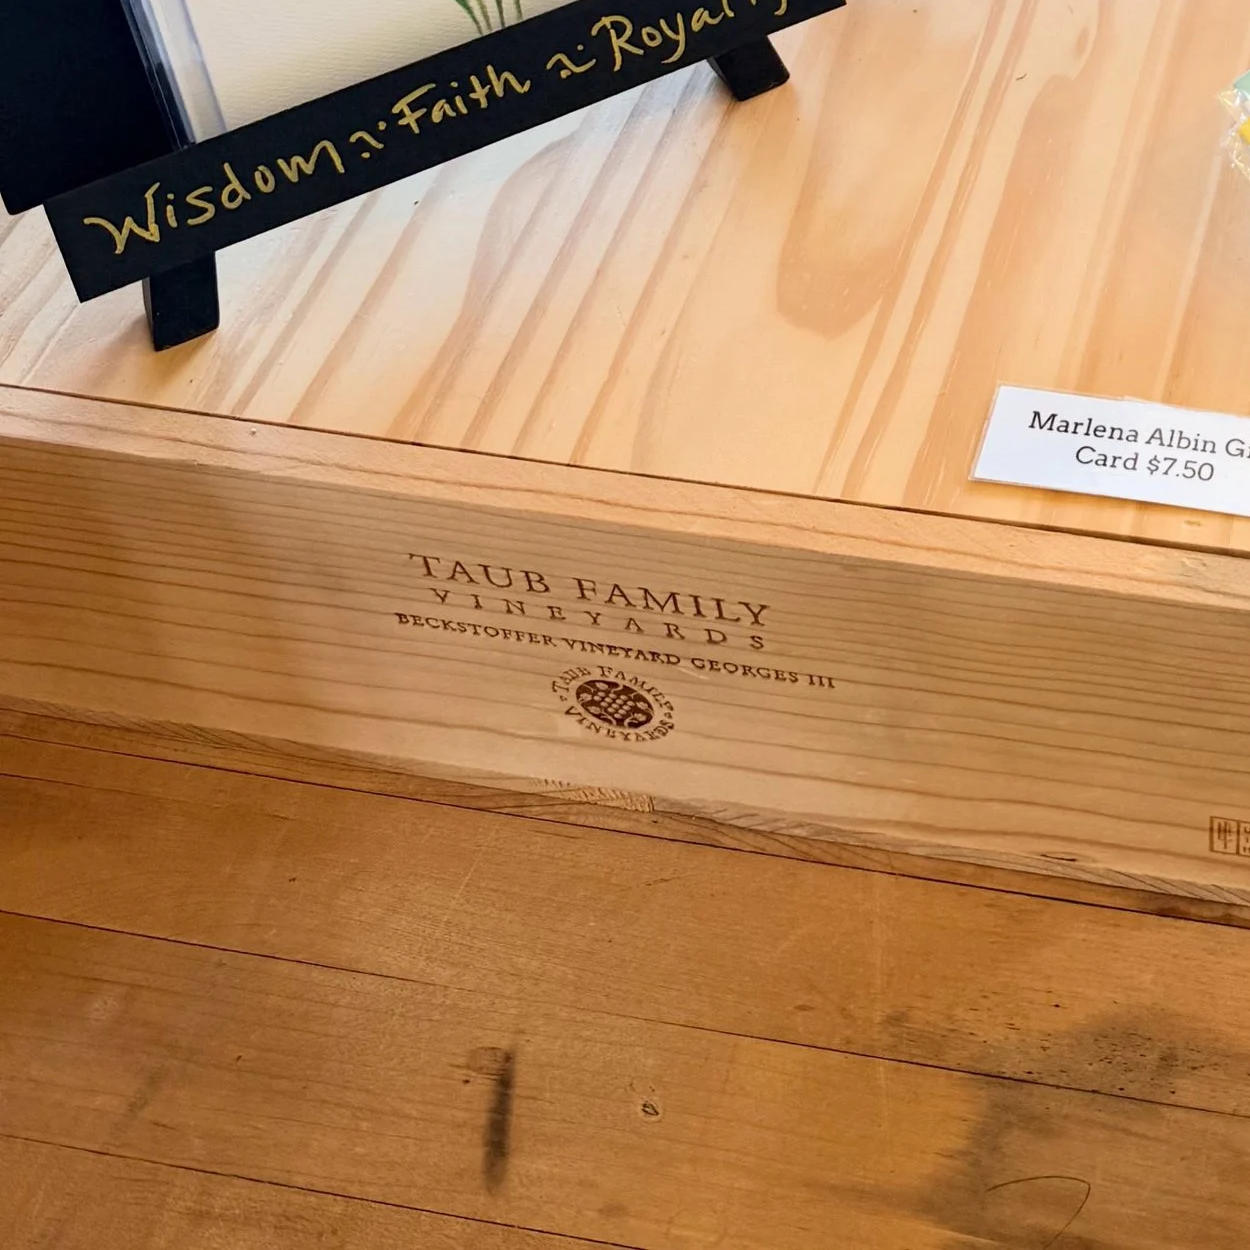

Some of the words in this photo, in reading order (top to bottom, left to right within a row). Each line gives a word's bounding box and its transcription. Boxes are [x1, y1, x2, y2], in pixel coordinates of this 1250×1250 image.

[84, 141, 344, 254] Wisdom
[391, 66, 529, 135] Faith
[1028, 410, 1138, 443] Marlena
[1145, 427, 1217, 454] Albin
[1075, 446, 1138, 471] Card
[1147, 454, 1215, 482] $7.50
[409, 553, 550, 593] TAUB
[572, 577, 770, 626] FAMILY
[429, 588, 765, 650] VINEYARDS
[394, 613, 557, 647] BECKSTOFFER
[560, 638, 680, 665] VINEYARD
[691, 658, 799, 683] GEORGES
[807, 674, 835, 689] III
